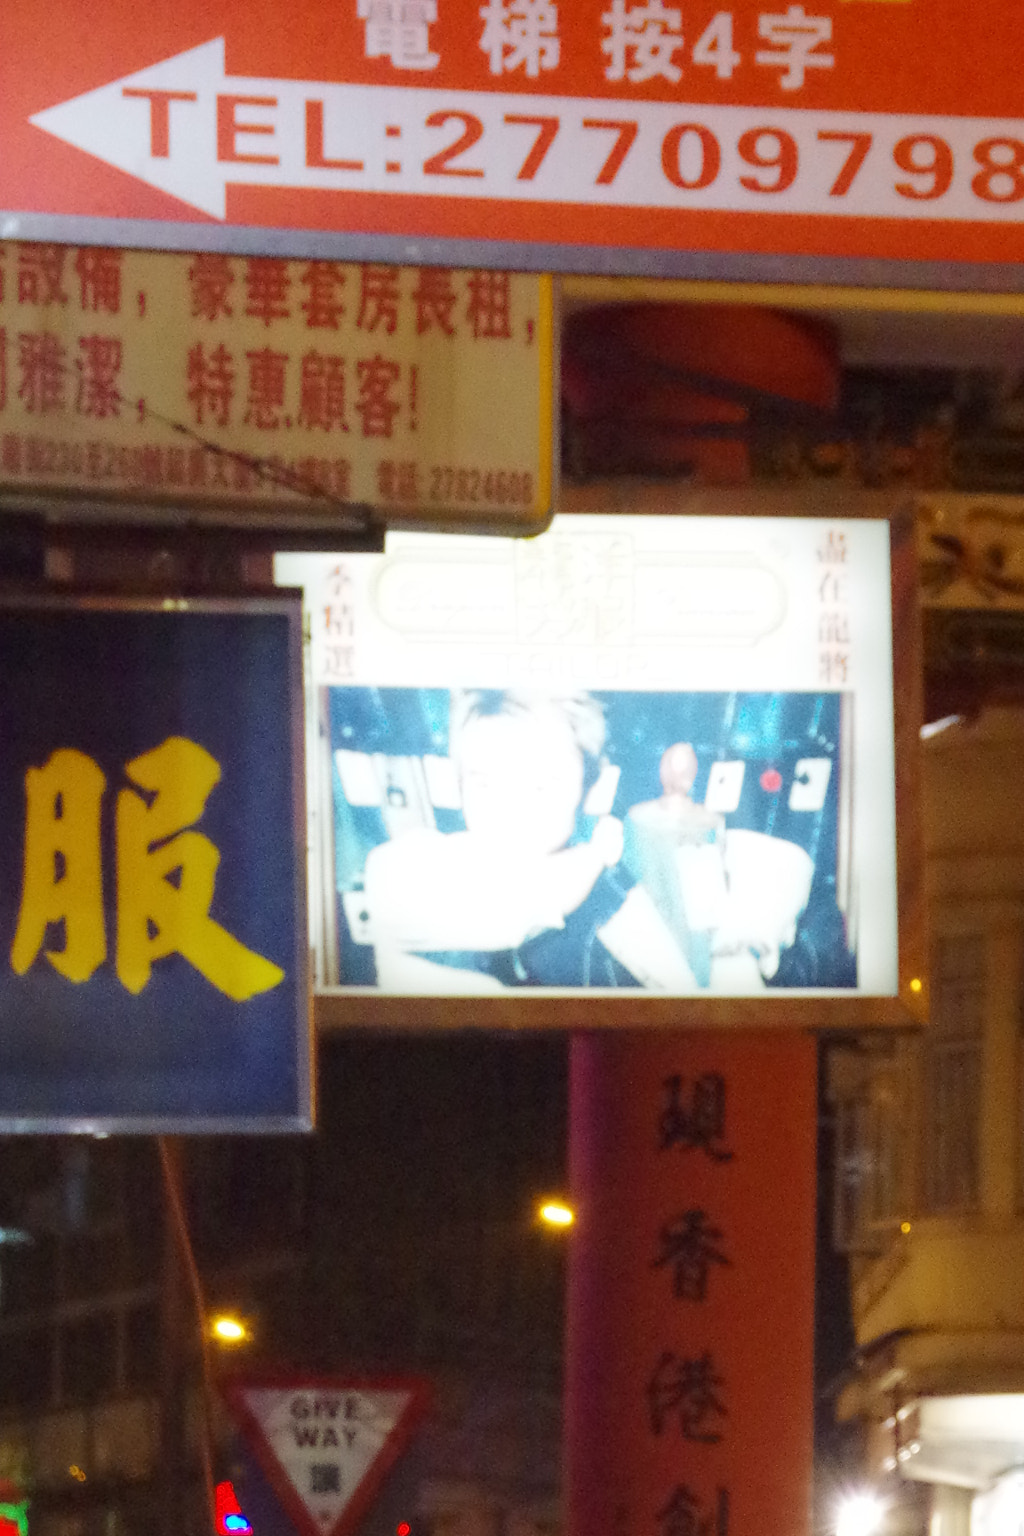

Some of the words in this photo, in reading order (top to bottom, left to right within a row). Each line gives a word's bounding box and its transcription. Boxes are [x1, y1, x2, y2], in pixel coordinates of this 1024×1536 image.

[356, 0, 835, 90] 電梯按4字
[10, 734, 286, 1002] 服
[290, 1395, 359, 1420] GIVE
[292, 1425, 359, 1448] WAY
